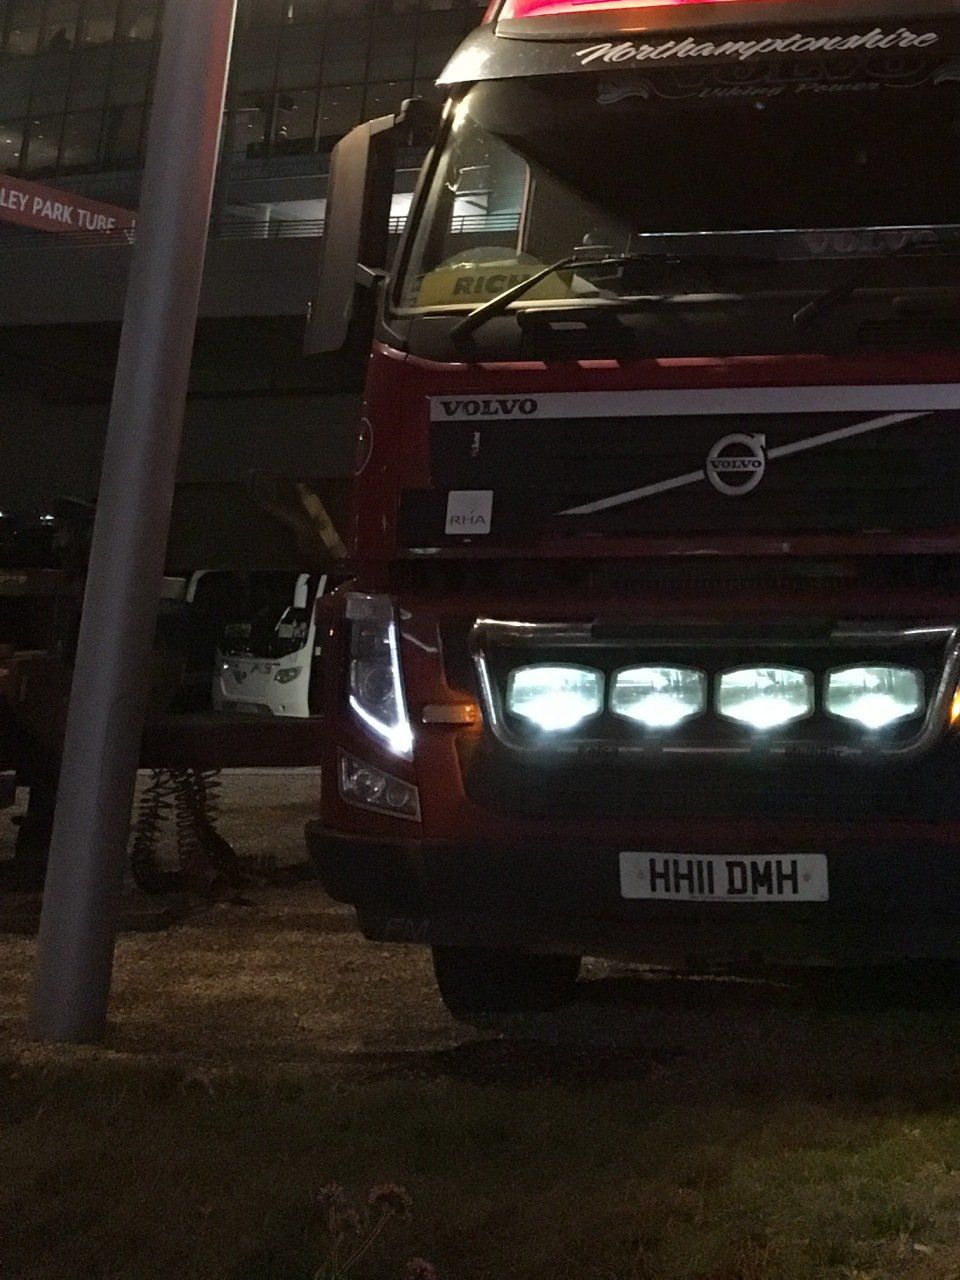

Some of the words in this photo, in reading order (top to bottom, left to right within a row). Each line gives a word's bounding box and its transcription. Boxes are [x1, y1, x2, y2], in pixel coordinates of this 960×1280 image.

[575, 28, 940, 65] Northamptonshire
[32, 197, 74, 224] PARK
[440, 399, 537, 416] VOLVO
[710, 460, 761, 469] VOLVO
[450, 515, 486, 526] RHA
[649, 858, 715, 894] HH11
[725, 860, 799, 895] DMH
